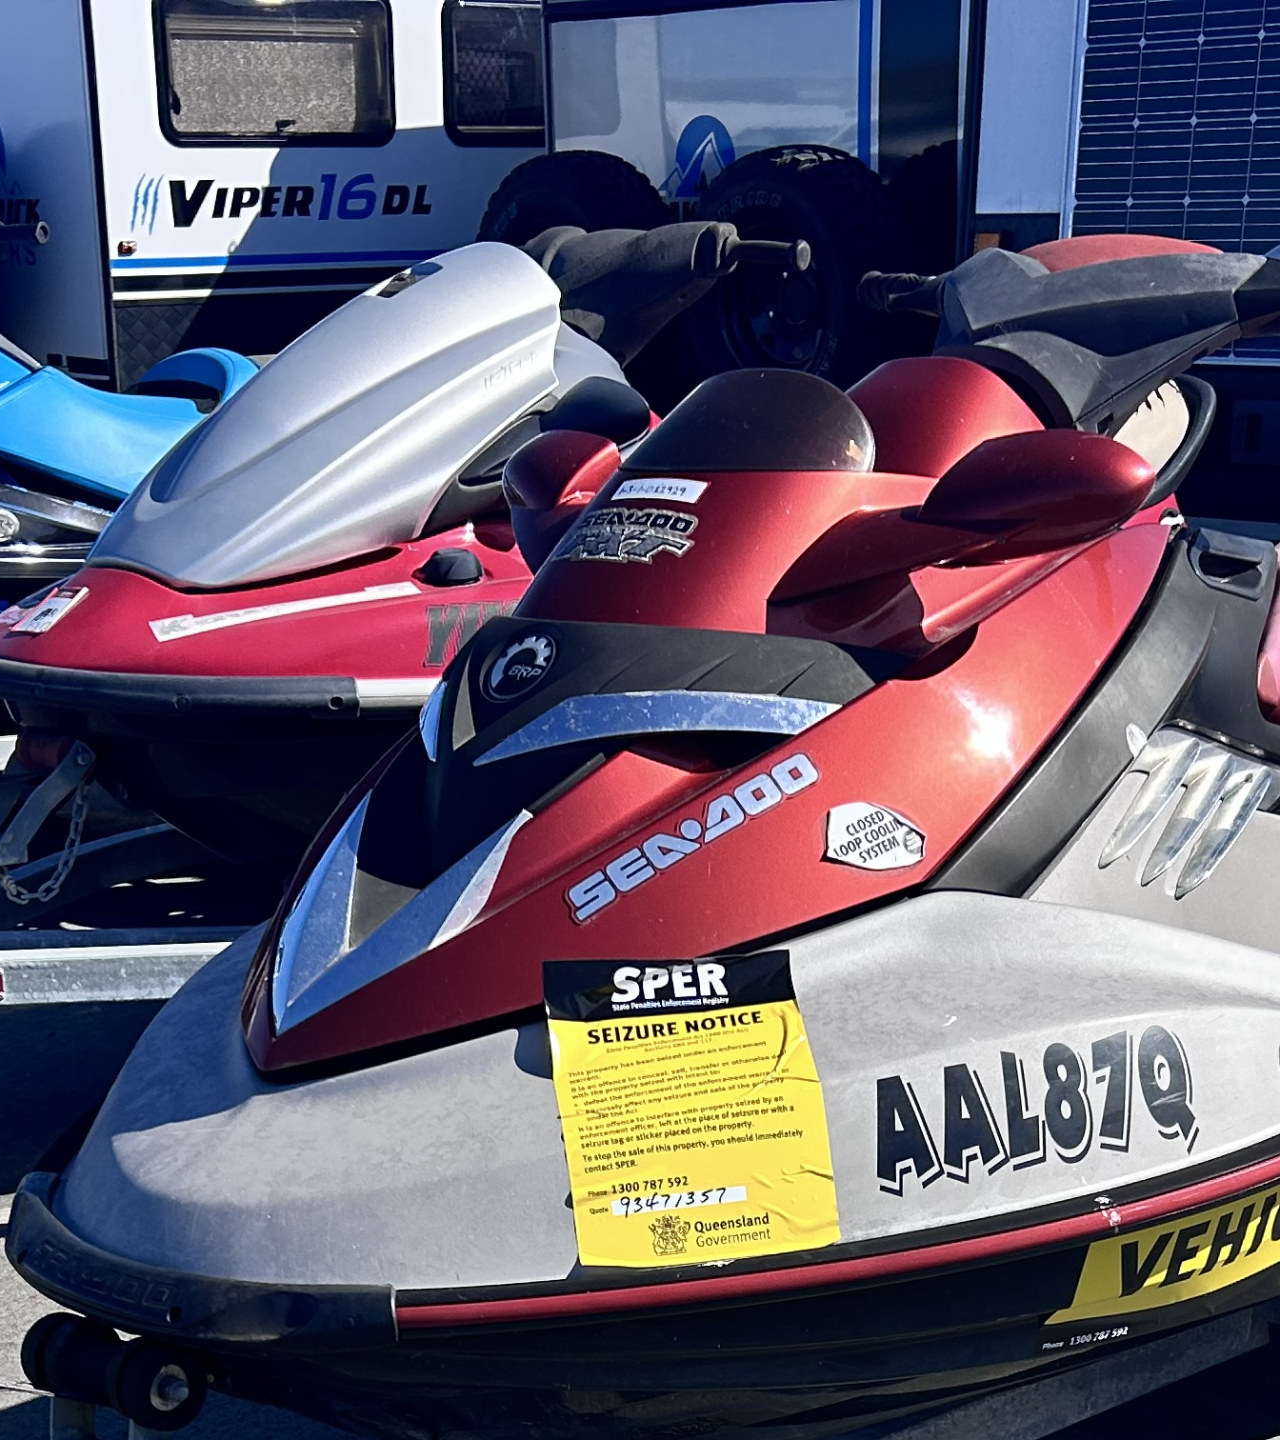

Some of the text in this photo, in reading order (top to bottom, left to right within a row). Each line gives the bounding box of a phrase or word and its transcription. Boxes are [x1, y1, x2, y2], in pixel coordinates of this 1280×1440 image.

[846, 810, 885, 837] CLOSED
[859, 835, 900, 864] SYSTEM
[611, 962, 728, 1003] SPER
[588, 1022, 679, 1045] SEIZURE
[685, 1011, 764, 1033] NOTICE
[876, 1024, 1199, 1197] AAL87Q
[664, 1127, 690, 1138] placed
[611, 1182, 639, 1194] 1300
[643, 1179, 663, 1190] 787
[667, 1176, 689, 1188] 592
[695, 1214, 770, 1234] Queensland
[696, 1228, 771, 1248] Government
[1070, 1334, 1092, 1345] 1300
[1093, 1330, 1111, 1341] 787
[1111, 1326, 1128, 1337] 592
